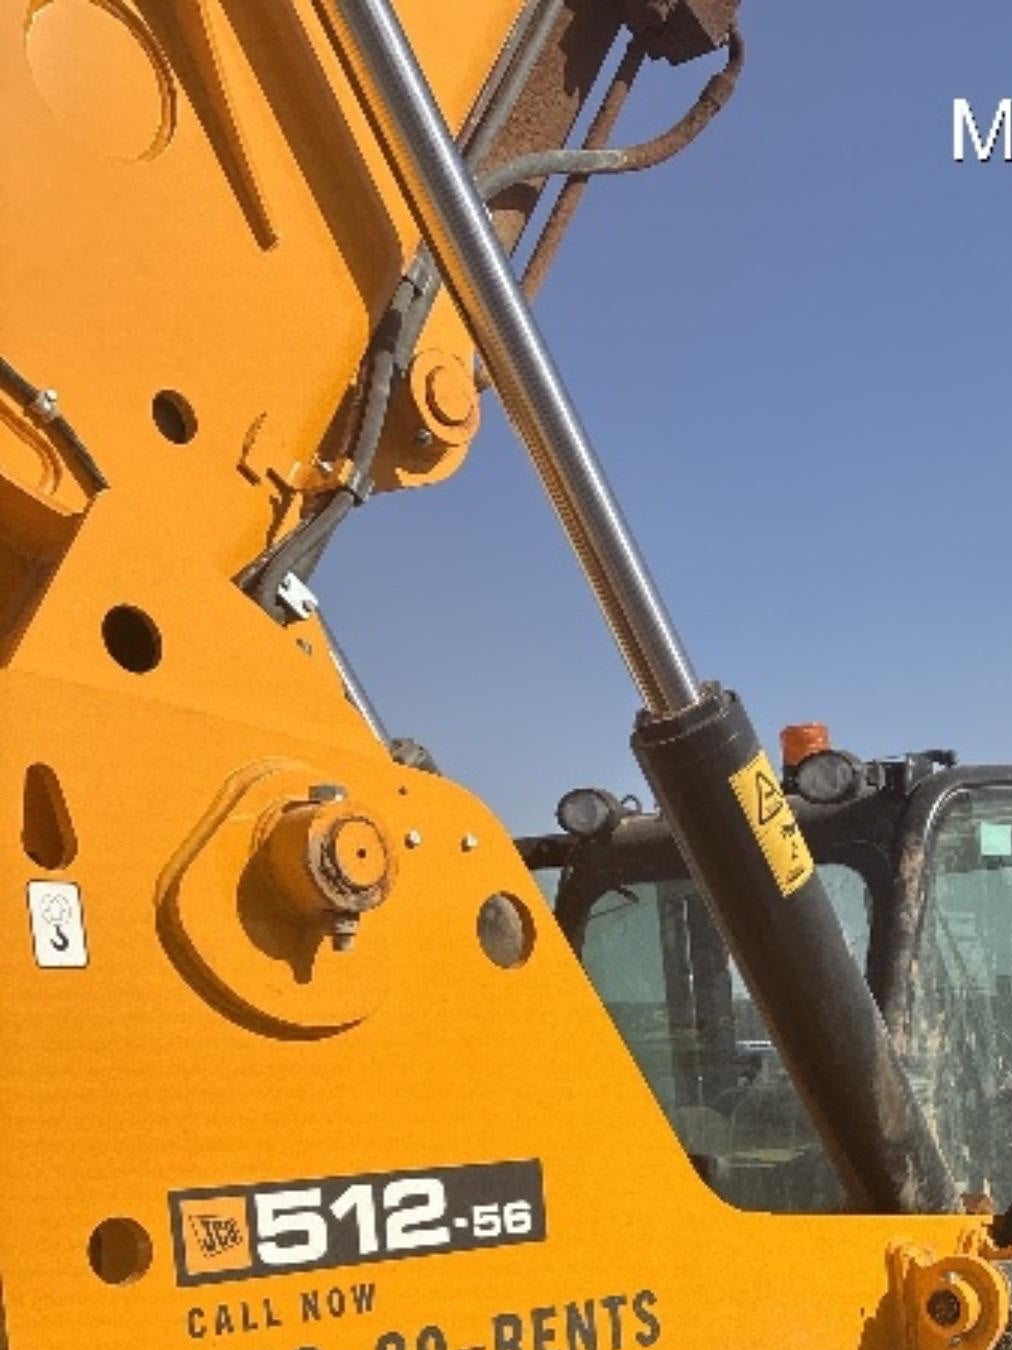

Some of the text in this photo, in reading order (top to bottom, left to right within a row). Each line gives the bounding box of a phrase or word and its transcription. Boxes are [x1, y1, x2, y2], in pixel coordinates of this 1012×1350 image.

[199, 1217, 241, 1253] JCB
[187, 1283, 377, 1339] CALL NOW
